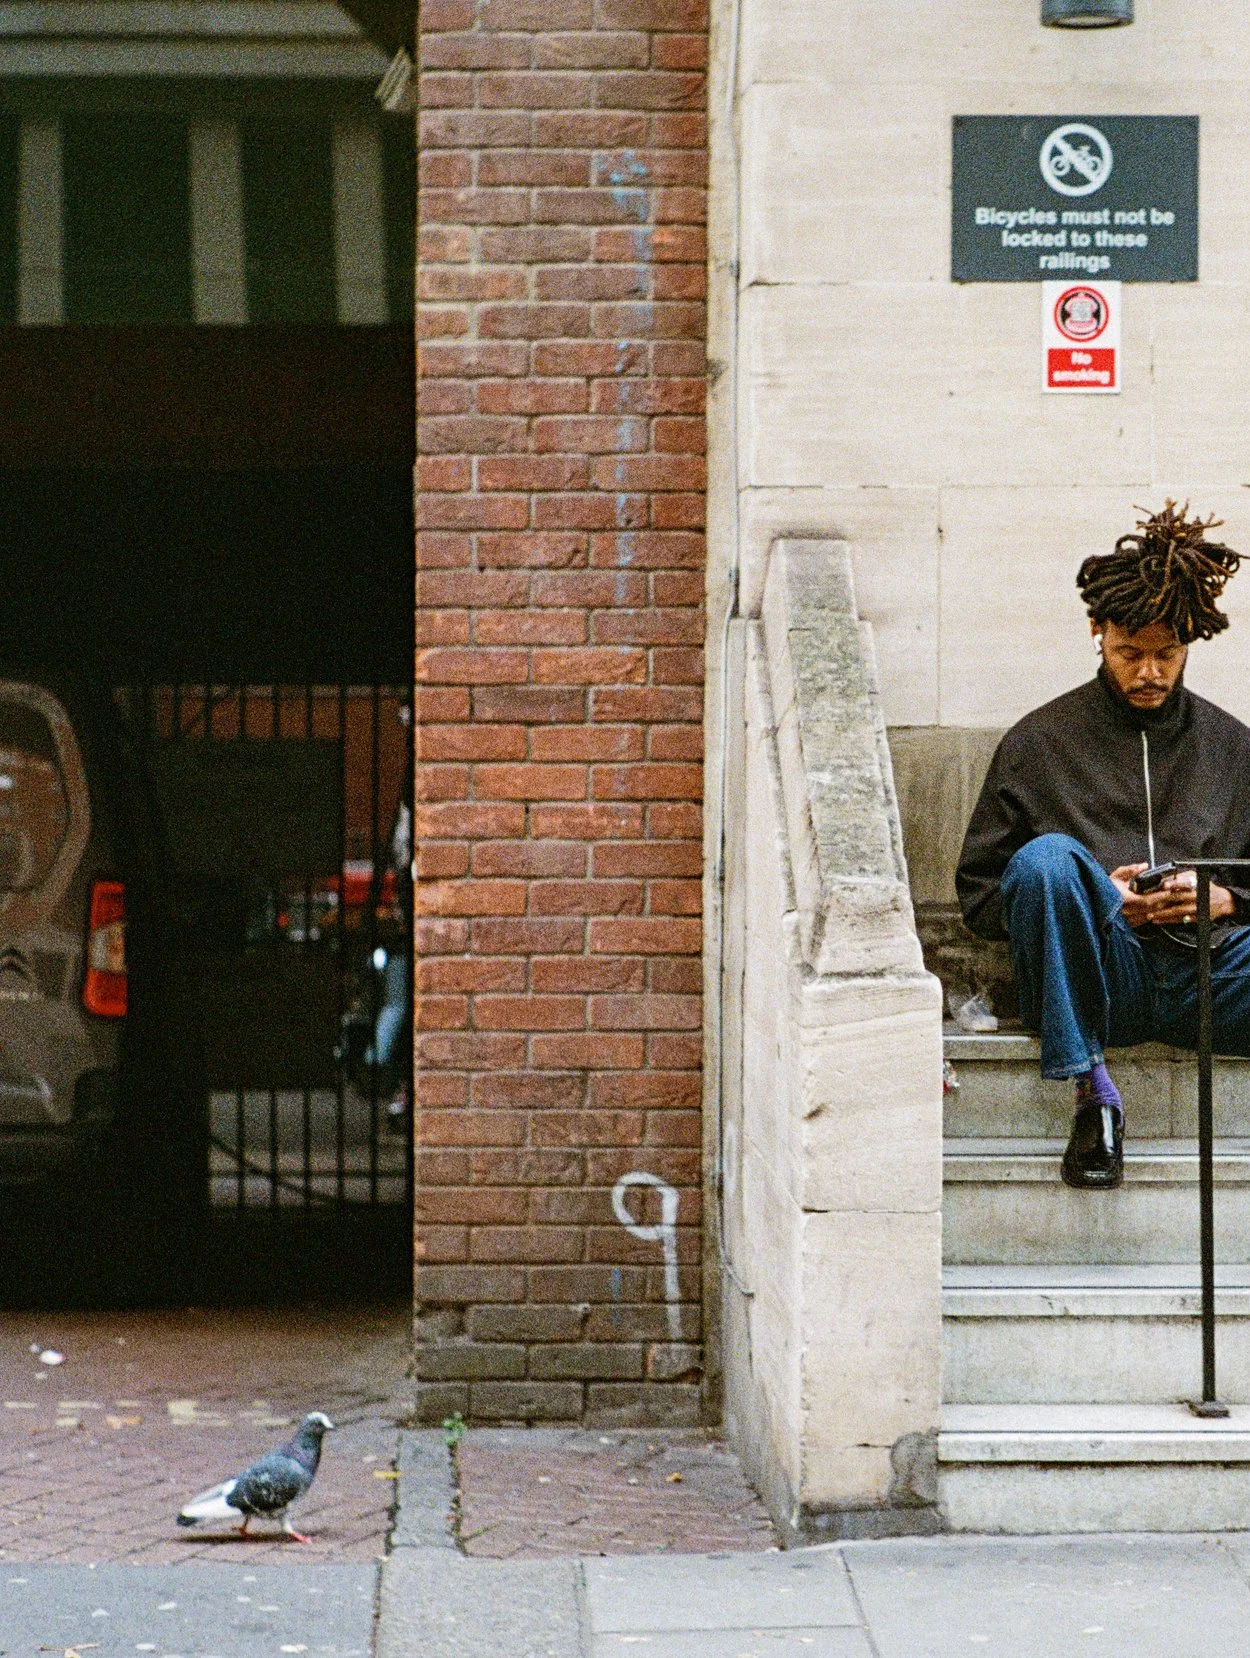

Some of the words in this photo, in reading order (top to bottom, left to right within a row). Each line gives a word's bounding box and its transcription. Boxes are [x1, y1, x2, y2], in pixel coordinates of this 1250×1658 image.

[974, 207, 1057, 228] Bicycles
[1061, 208, 1110, 226] must
[1114, 208, 1146, 226] not
[1150, 207, 1176, 225] be
[1001, 230, 1068, 248] locked
[1070, 231, 1090, 248] to
[1094, 230, 1148, 248] these
[1039, 252, 1111, 273] railings
[1070, 351, 1093, 365] No
[1052, 368, 1111, 384] smoking
